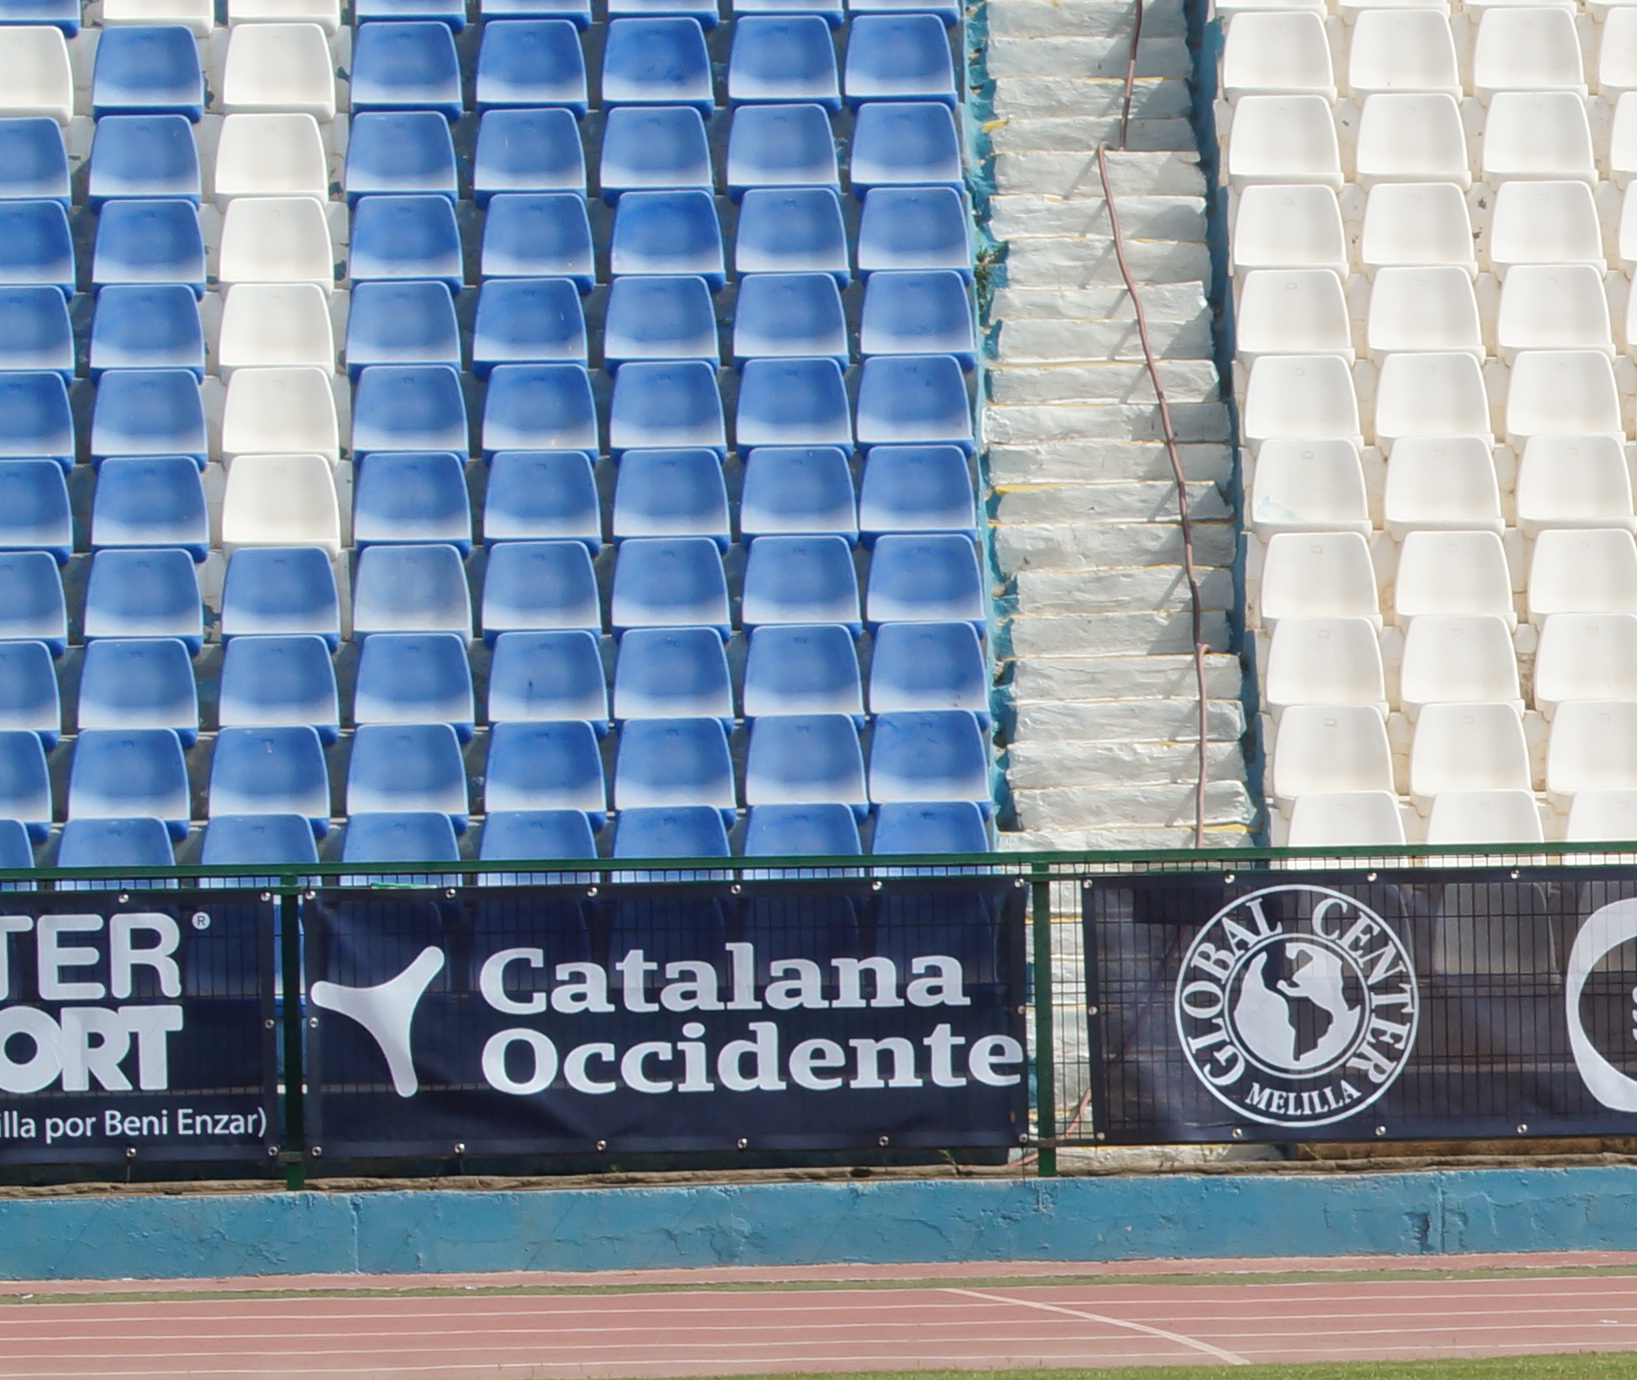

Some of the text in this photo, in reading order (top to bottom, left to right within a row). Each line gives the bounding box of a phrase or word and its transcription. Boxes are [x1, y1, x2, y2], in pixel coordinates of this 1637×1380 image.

[479, 942, 971, 1015] Catalana
[1181, 897, 1284, 1086] GLOBAL
[1311, 897, 1416, 1084] CENTER
[0, 1004, 184, 1094] ORT
[481, 1021, 1024, 1095] Occidente
[45, 1116, 97, 1145] por
[104, 1109, 168, 1137] Beni
[177, 1106, 267, 1138] Enzar)
[1243, 1078, 1363, 1116] MELILLA
